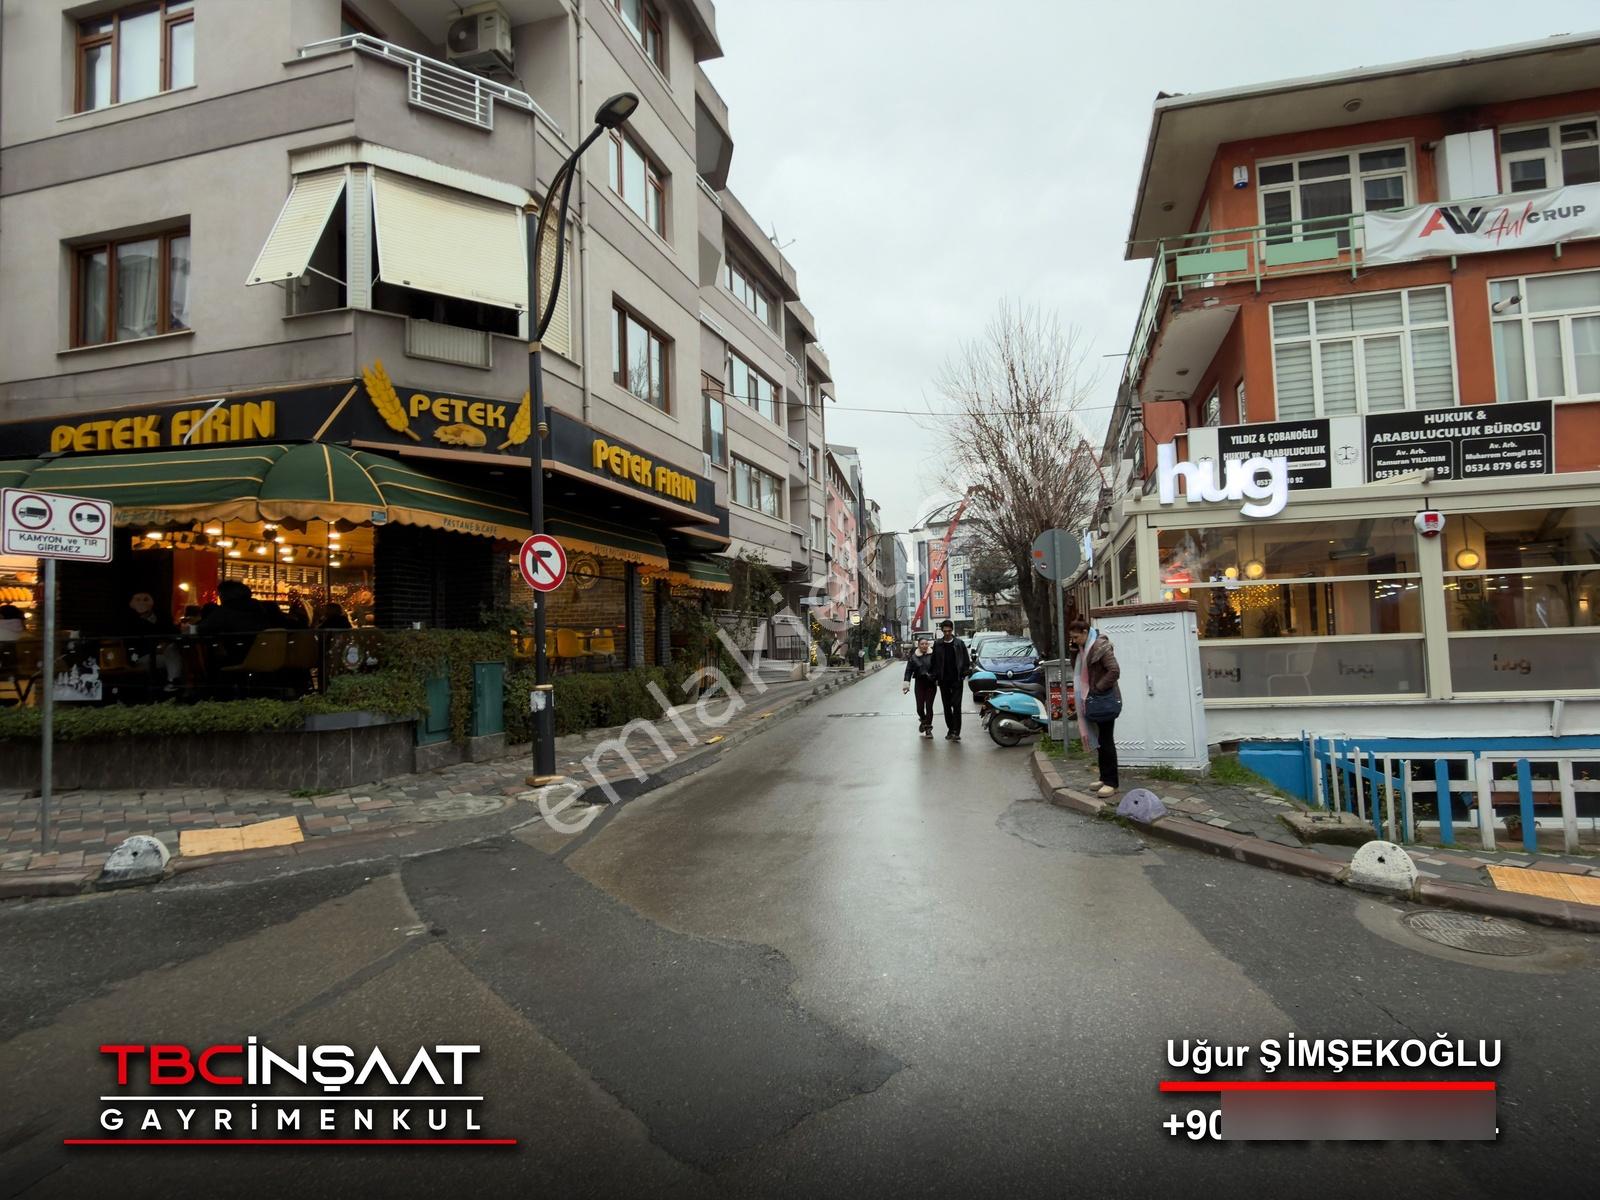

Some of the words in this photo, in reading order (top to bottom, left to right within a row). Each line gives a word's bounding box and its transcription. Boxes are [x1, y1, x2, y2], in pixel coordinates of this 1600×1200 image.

[1526, 205, 1586, 224] GRUP
[408, 393, 507, 429] PETEK
[1424, 411, 1474, 424] HUKUK
[1475, 410, 1487, 421] &
[51, 414, 161, 453] PETEK
[171, 400, 275, 447] FIRIN
[1372, 428, 1482, 444] ARABULUCULUK
[1484, 421, 1542, 436] BÜROSU
[1230, 433, 1257, 445] YILDIZ
[1258, 433, 1266, 443] &
[1267, 427, 1318, 444] ÇOBANOĞLU
[1223, 451, 1250, 461] HUKUK
[1262, 445, 1326, 459] ARABULUCULUK
[1502, 441, 1518, 449] Arb.
[1410, 455, 1446, 464] YILDIRIM
[1465, 463, 1491, 473] 0534
[1492, 461, 1512, 471] 879
[1514, 460, 1528, 470] 66
[1529, 460, 1543, 469] 55
[592, 438, 653, 489] PETEK
[654, 466, 697, 504] FIRIN
[1437, 466, 1450, 475] 93
[1157, 442, 1289, 518] hug
[18, 533, 63, 544] KAMYON
[67, 538, 78, 546] ve
[83, 538, 98, 547] TIR
[37, 543, 81, 554] GİREMEZ
